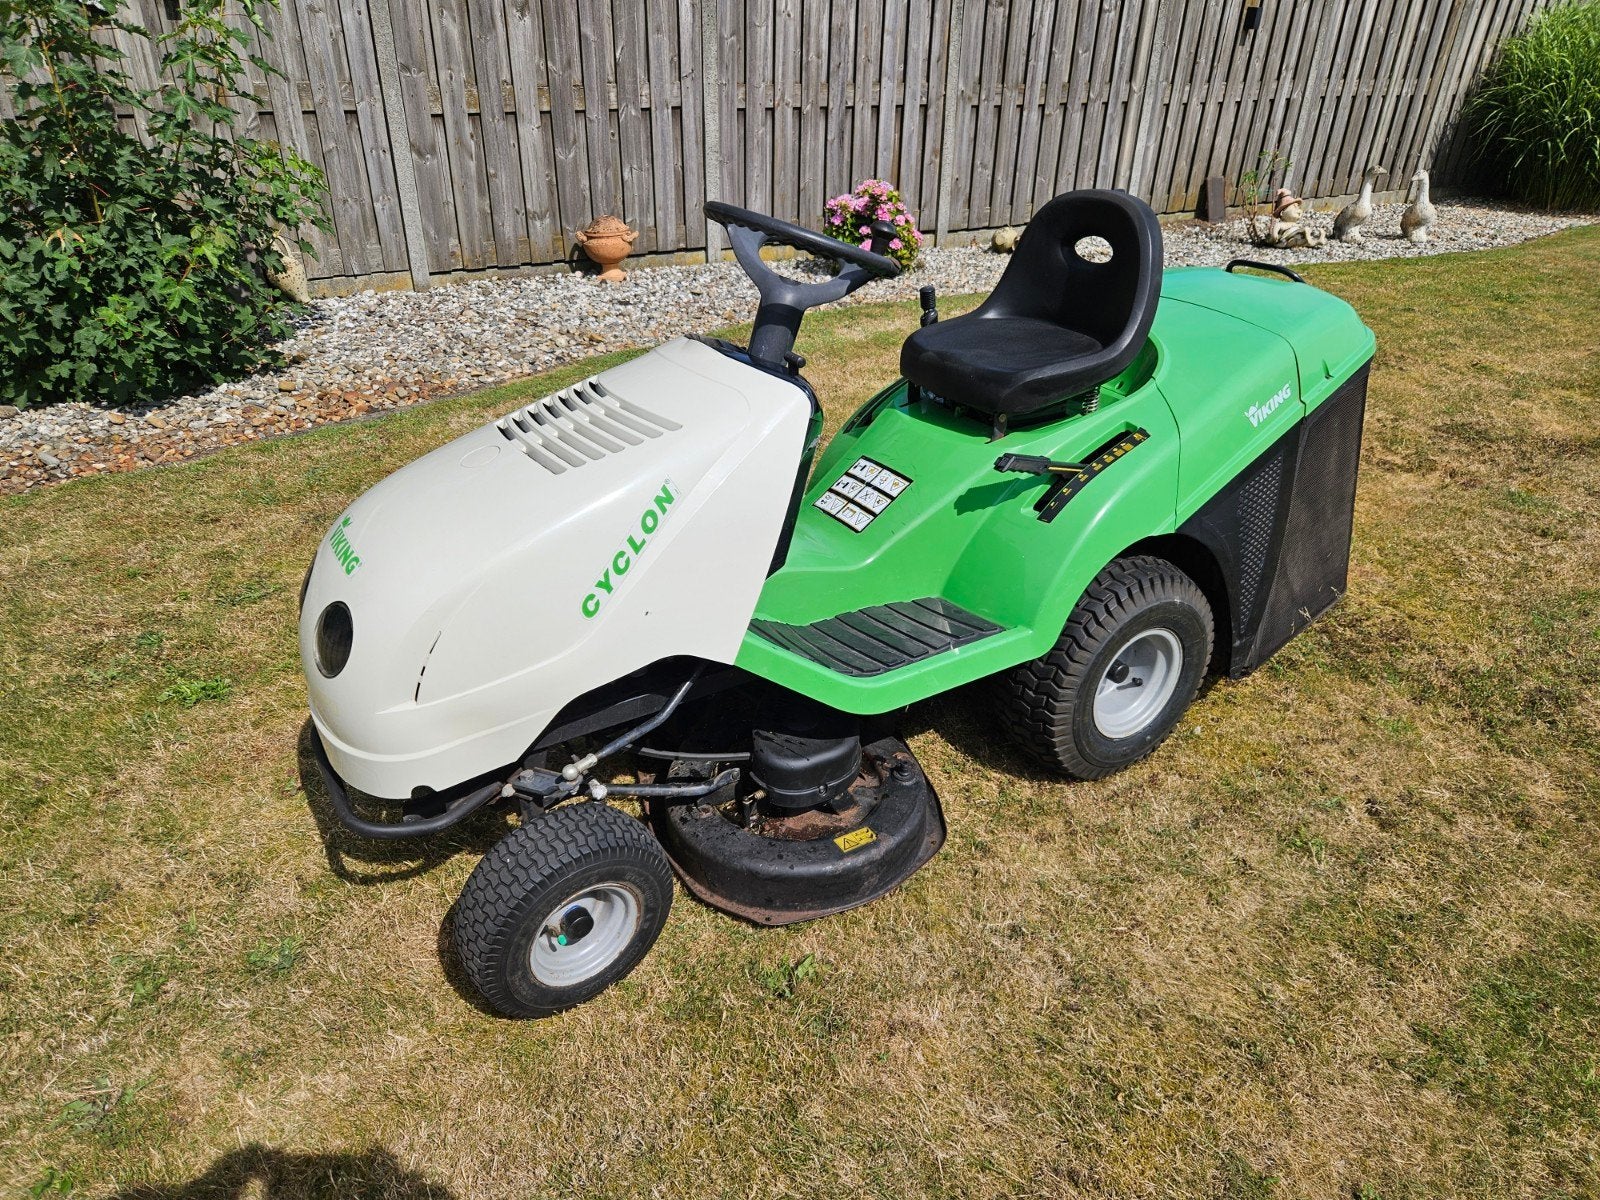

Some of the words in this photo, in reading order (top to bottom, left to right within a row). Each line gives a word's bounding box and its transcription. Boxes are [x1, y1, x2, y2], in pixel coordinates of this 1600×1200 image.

[1247, 382, 1292, 428] VIKING
[329, 523, 361, 575] VIKING
[581, 484, 675, 618] CYCLON
